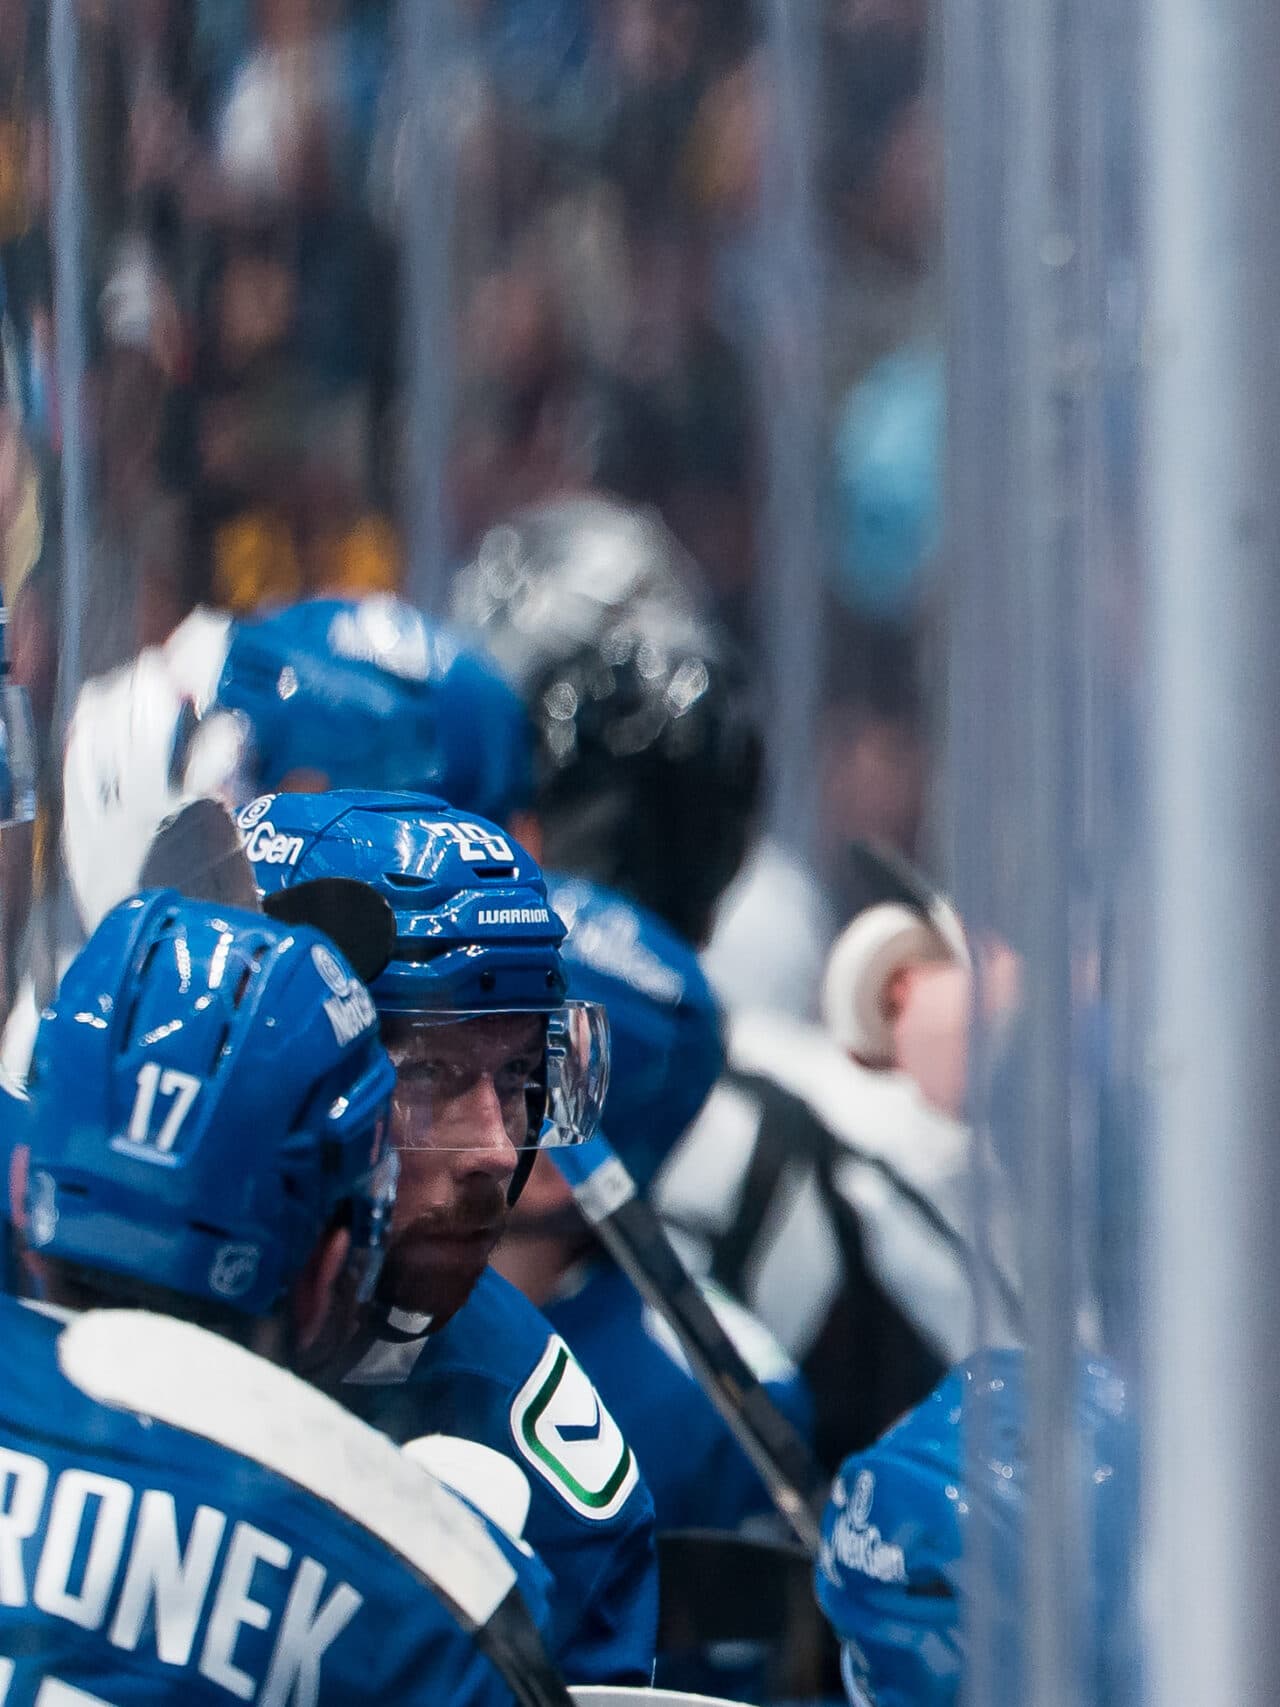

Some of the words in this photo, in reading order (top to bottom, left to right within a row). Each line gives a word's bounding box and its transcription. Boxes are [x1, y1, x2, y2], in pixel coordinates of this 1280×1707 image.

[478, 908, 549, 925] WARRIOR
[128, 1061, 201, 1152] 17
[0, 1445, 364, 1707] RONEK
